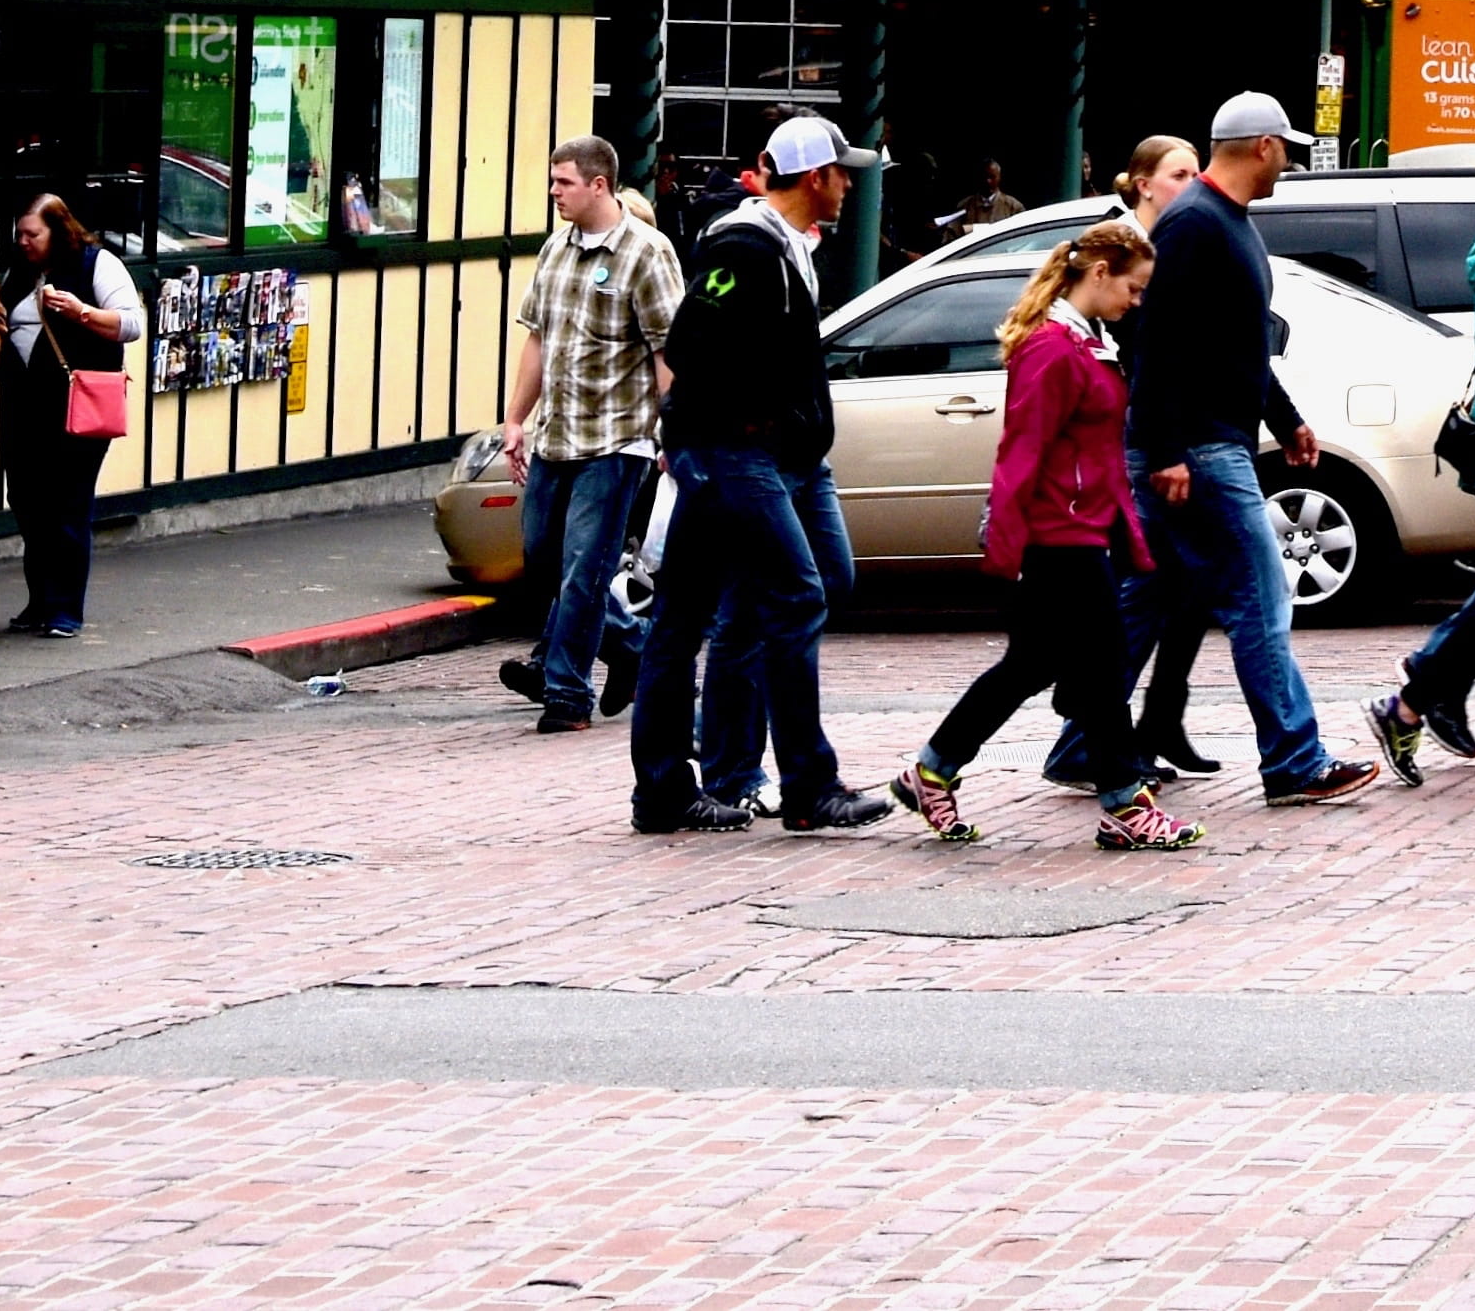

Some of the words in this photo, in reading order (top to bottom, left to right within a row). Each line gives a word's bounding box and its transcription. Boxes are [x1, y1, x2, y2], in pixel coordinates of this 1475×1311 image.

[1421, 34, 1474, 57] lean
[1439, 93, 1475, 108] grams
[1440, 107, 1453, 119] in
[1453, 107, 1471, 119] 70
